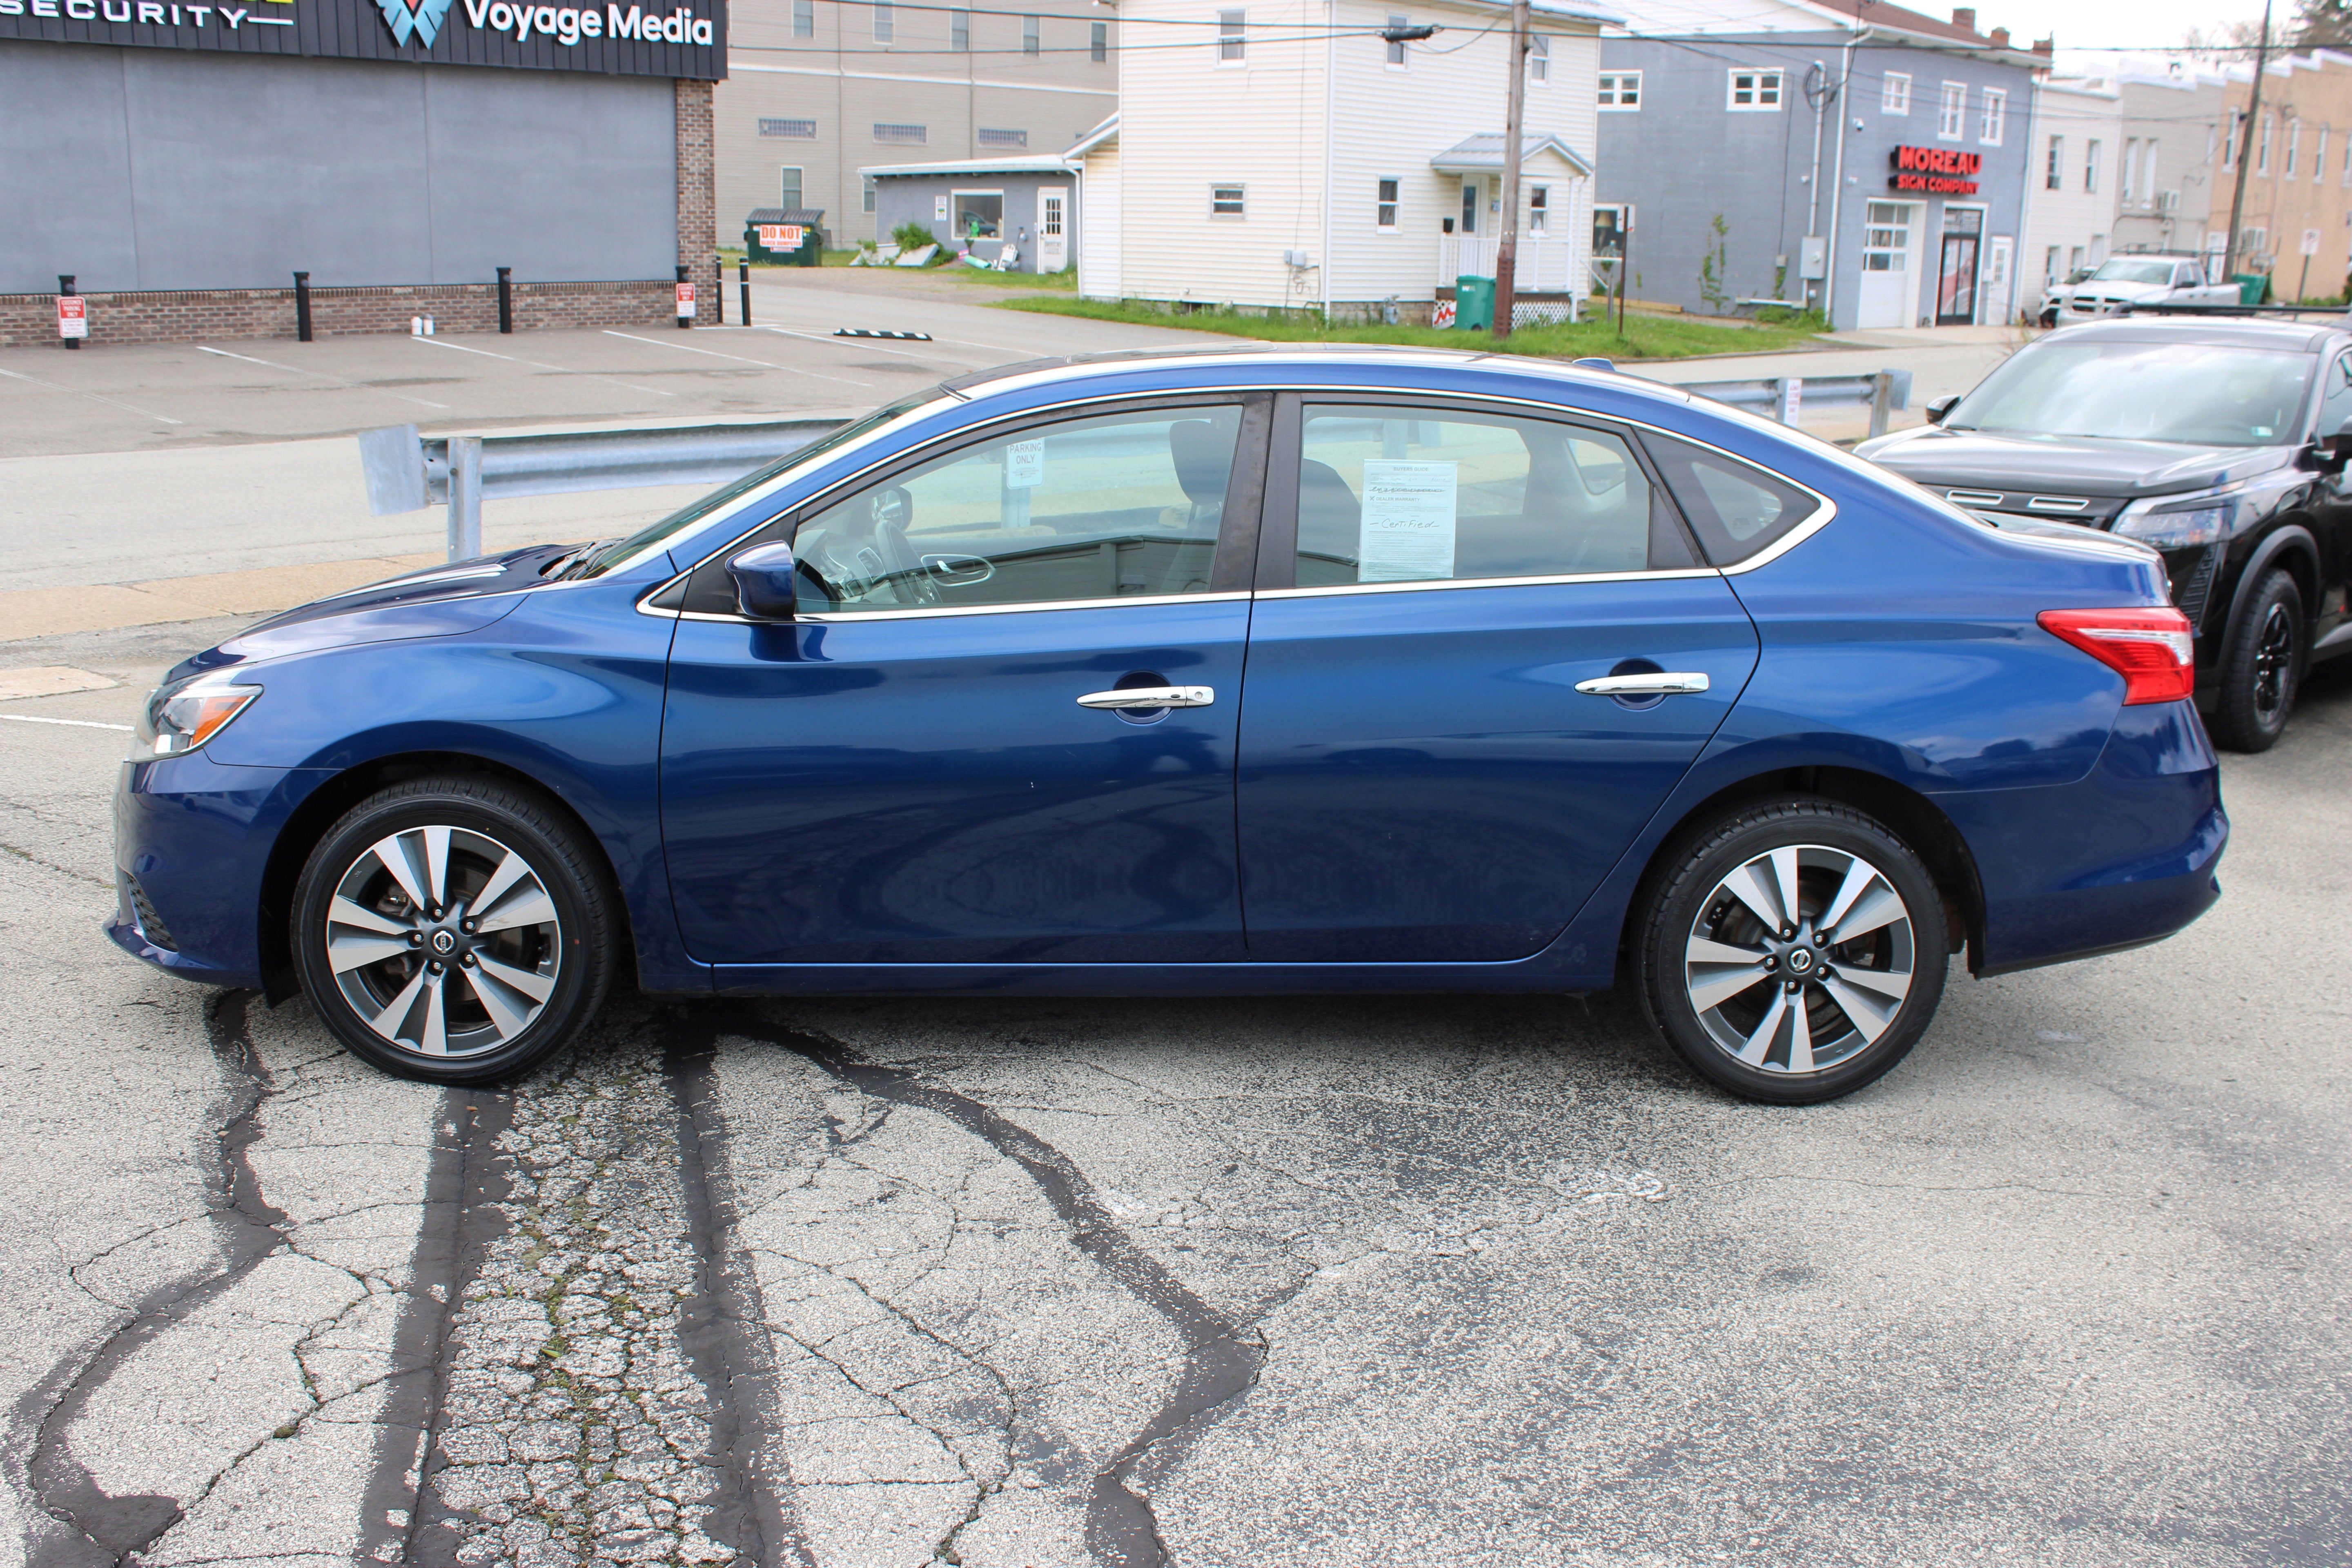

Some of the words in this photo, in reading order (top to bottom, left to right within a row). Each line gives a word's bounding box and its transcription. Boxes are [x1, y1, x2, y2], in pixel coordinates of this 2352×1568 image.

[0, 0, 247, 29] SECURITY
[463, 0, 602, 45] Voyage
[608, 3, 713, 45] Media
[1899, 144, 1982, 175] MOREAU
[1897, 174, 1927, 190] SIGN
[1928, 176, 1979, 194] COMPANY
[762, 227, 776, 238] DO
[780, 227, 801, 239] NOT
[1009, 443, 1042, 453] PARKING
[1016, 454, 1036, 464] ONLY
